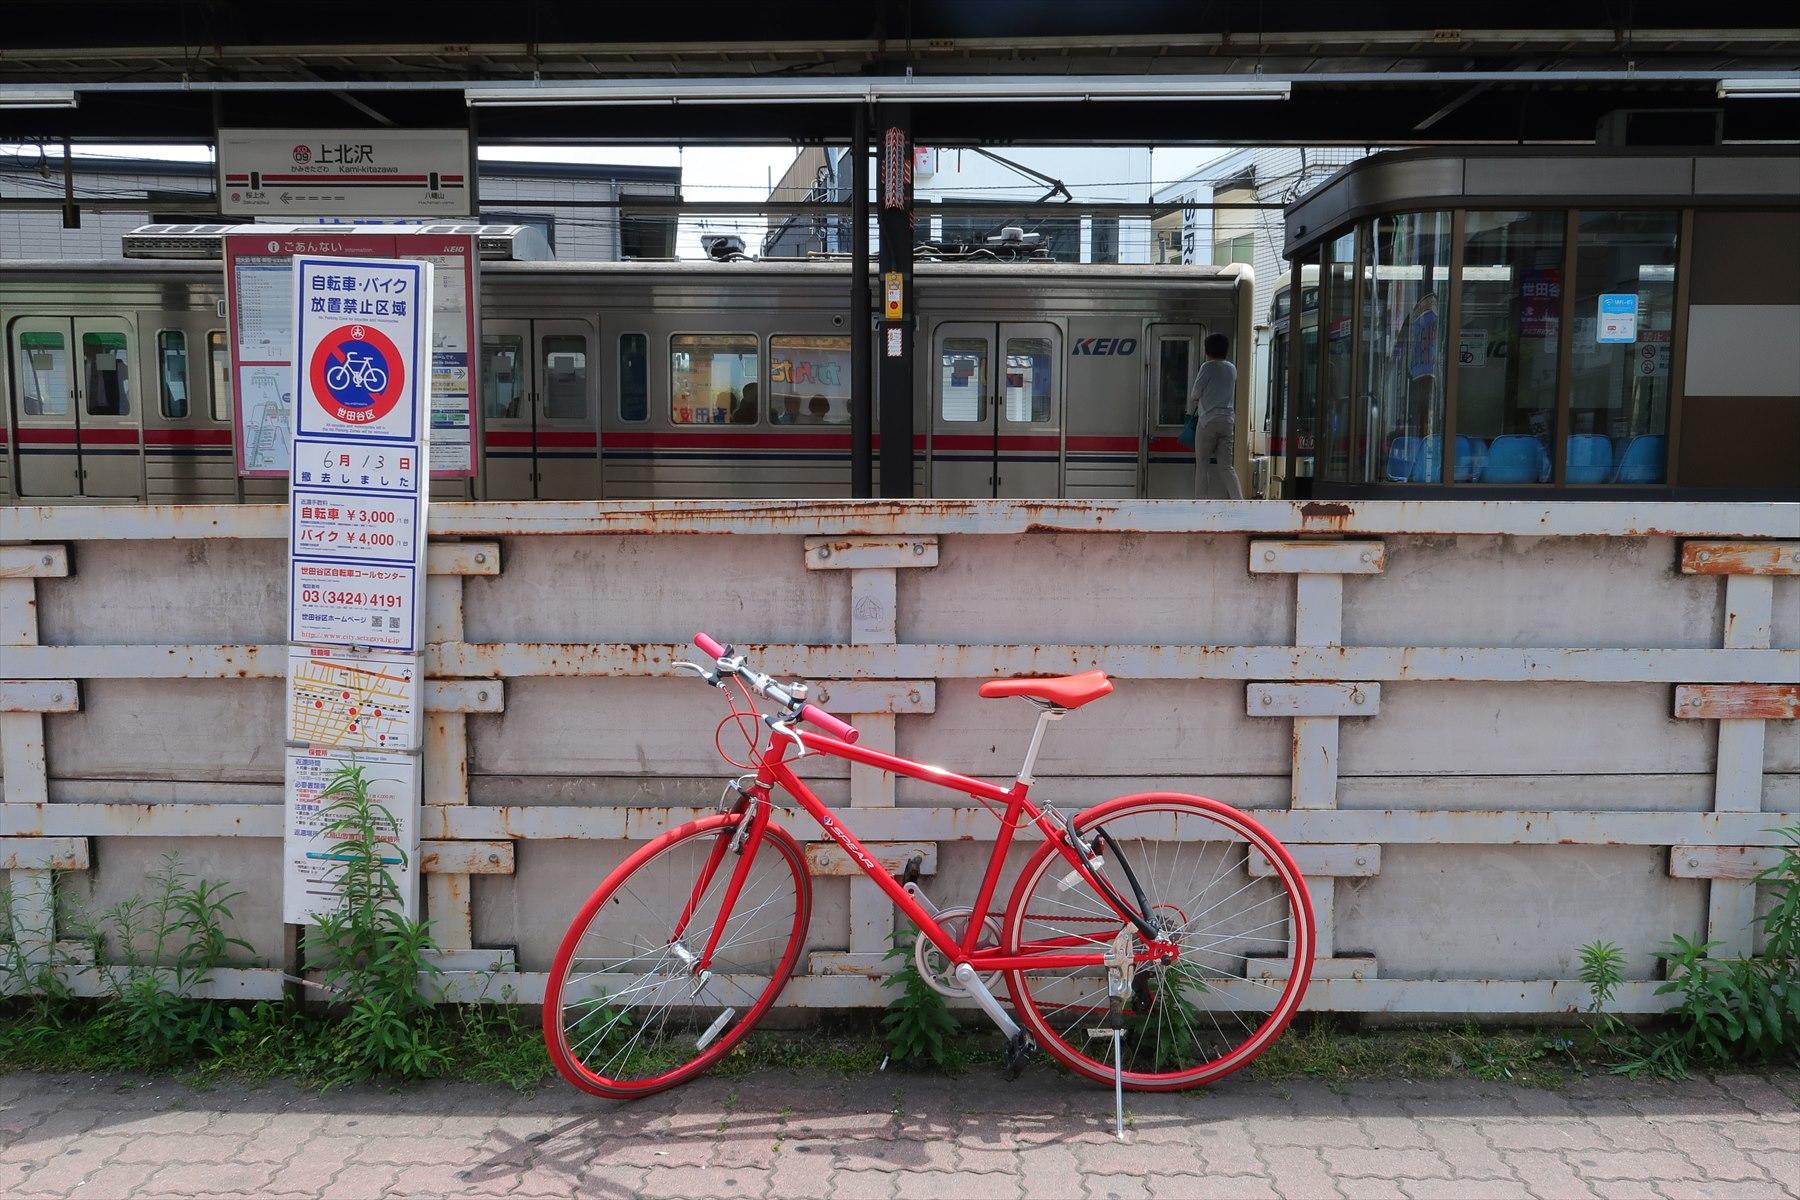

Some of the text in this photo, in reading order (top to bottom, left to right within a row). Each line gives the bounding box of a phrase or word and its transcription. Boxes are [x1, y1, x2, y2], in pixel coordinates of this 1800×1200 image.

[315, 144, 374, 163] 上北沢
[284, 241, 343, 252] ごあんない
[312, 275, 407, 294] 自転車・バイク
[311, 297, 407, 317] 放置禁止区域
[1071, 337, 1138, 356] KEIO
[337, 407, 376, 422] 世田谷区
[302, 507, 340, 520] 自転車
[301, 529, 339, 542] バイク
[301, 567, 406, 580] 世田谷区自転車コールセンター
[302, 613, 367, 624] 世田谷区ホームページ
[829, 826, 875, 869] SPEAR
